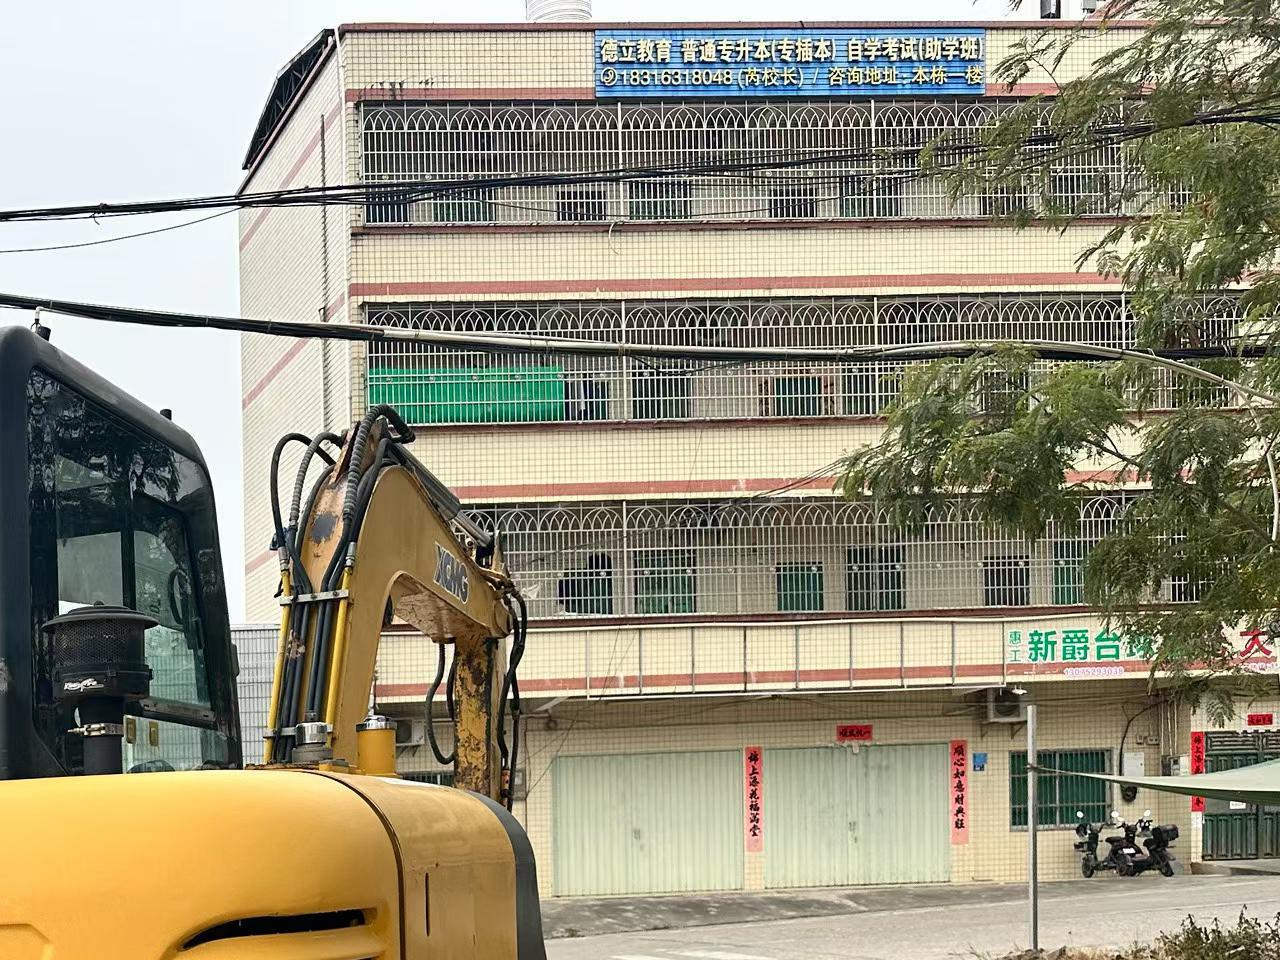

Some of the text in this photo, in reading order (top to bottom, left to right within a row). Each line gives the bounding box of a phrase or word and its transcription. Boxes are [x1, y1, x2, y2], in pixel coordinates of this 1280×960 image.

[600, 36, 983, 63] 德立教育 普通专升本(专插本) 自学考试(助学班)
[621, 68, 733, 86] 18316318048
[433, 541, 469, 604] XCMG
